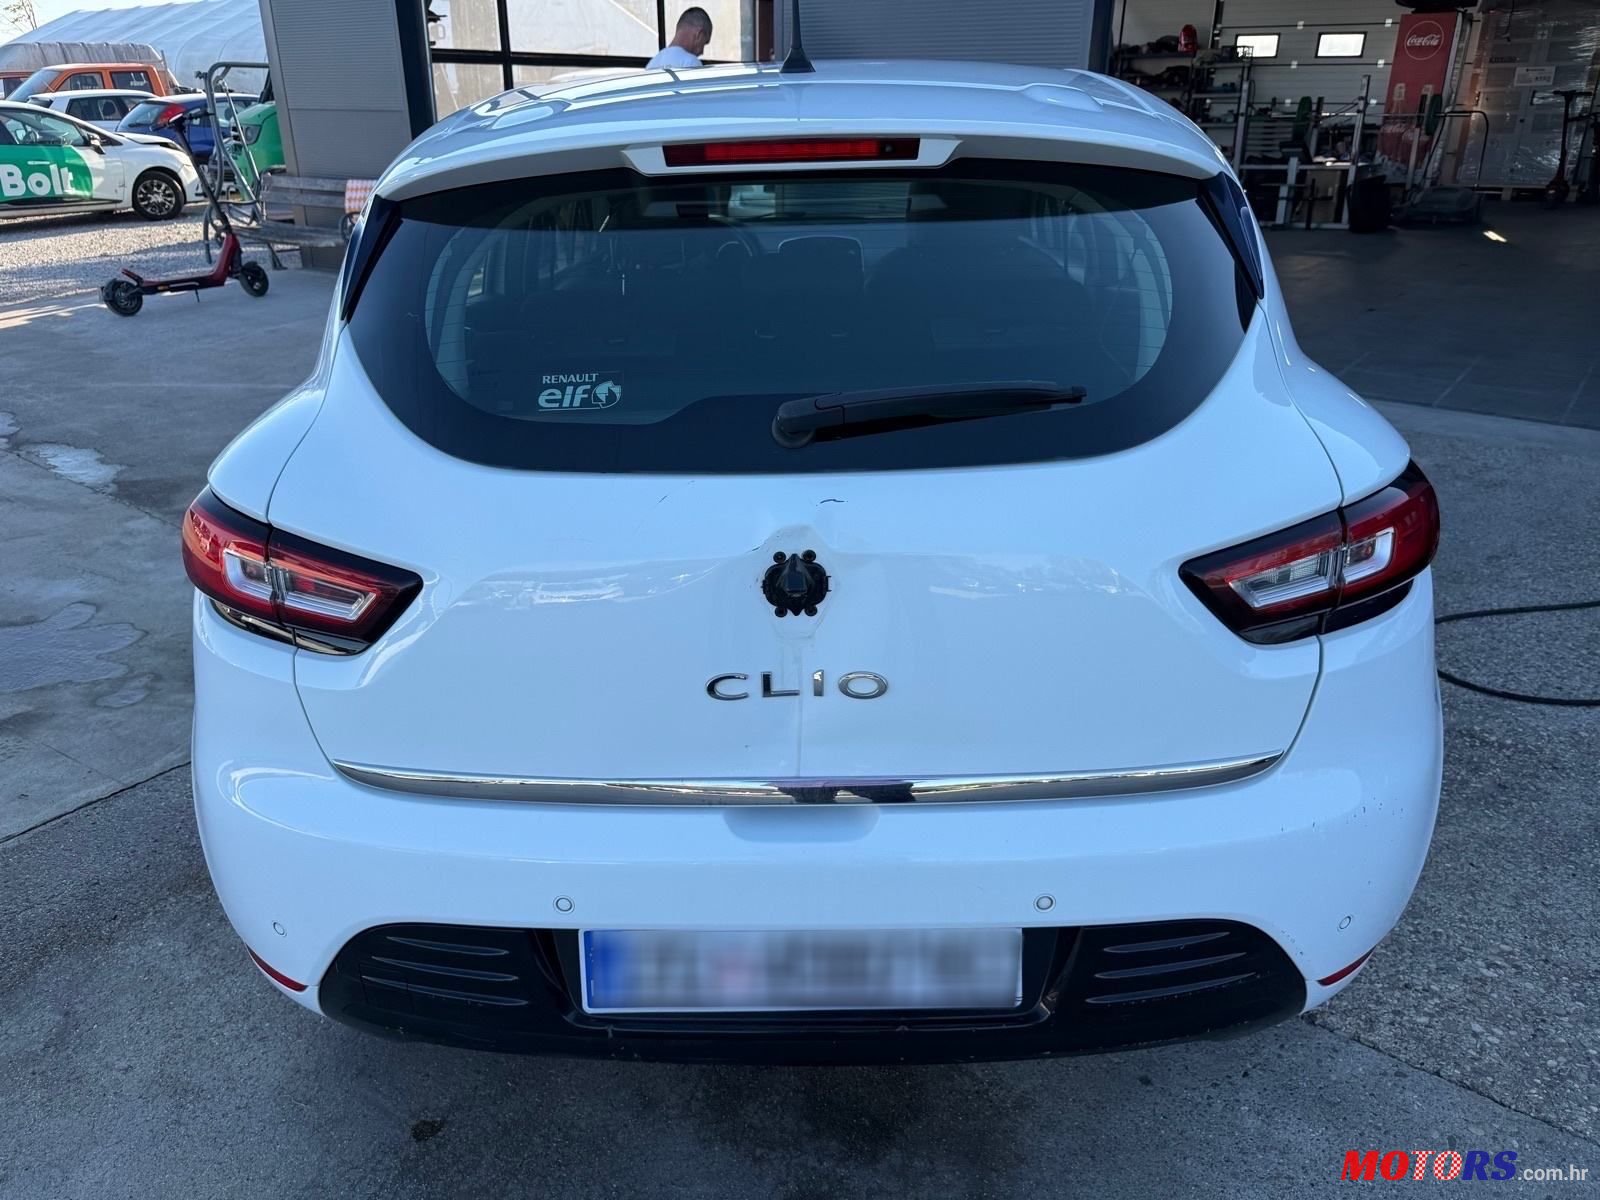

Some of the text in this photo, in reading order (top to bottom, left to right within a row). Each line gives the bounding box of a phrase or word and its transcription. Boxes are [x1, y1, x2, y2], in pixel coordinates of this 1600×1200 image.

[0, 164, 74, 197] Bolt
[542, 373, 599, 384] RENAULT
[538, 385, 592, 408] elf
[706, 670, 889, 700] CLIO
